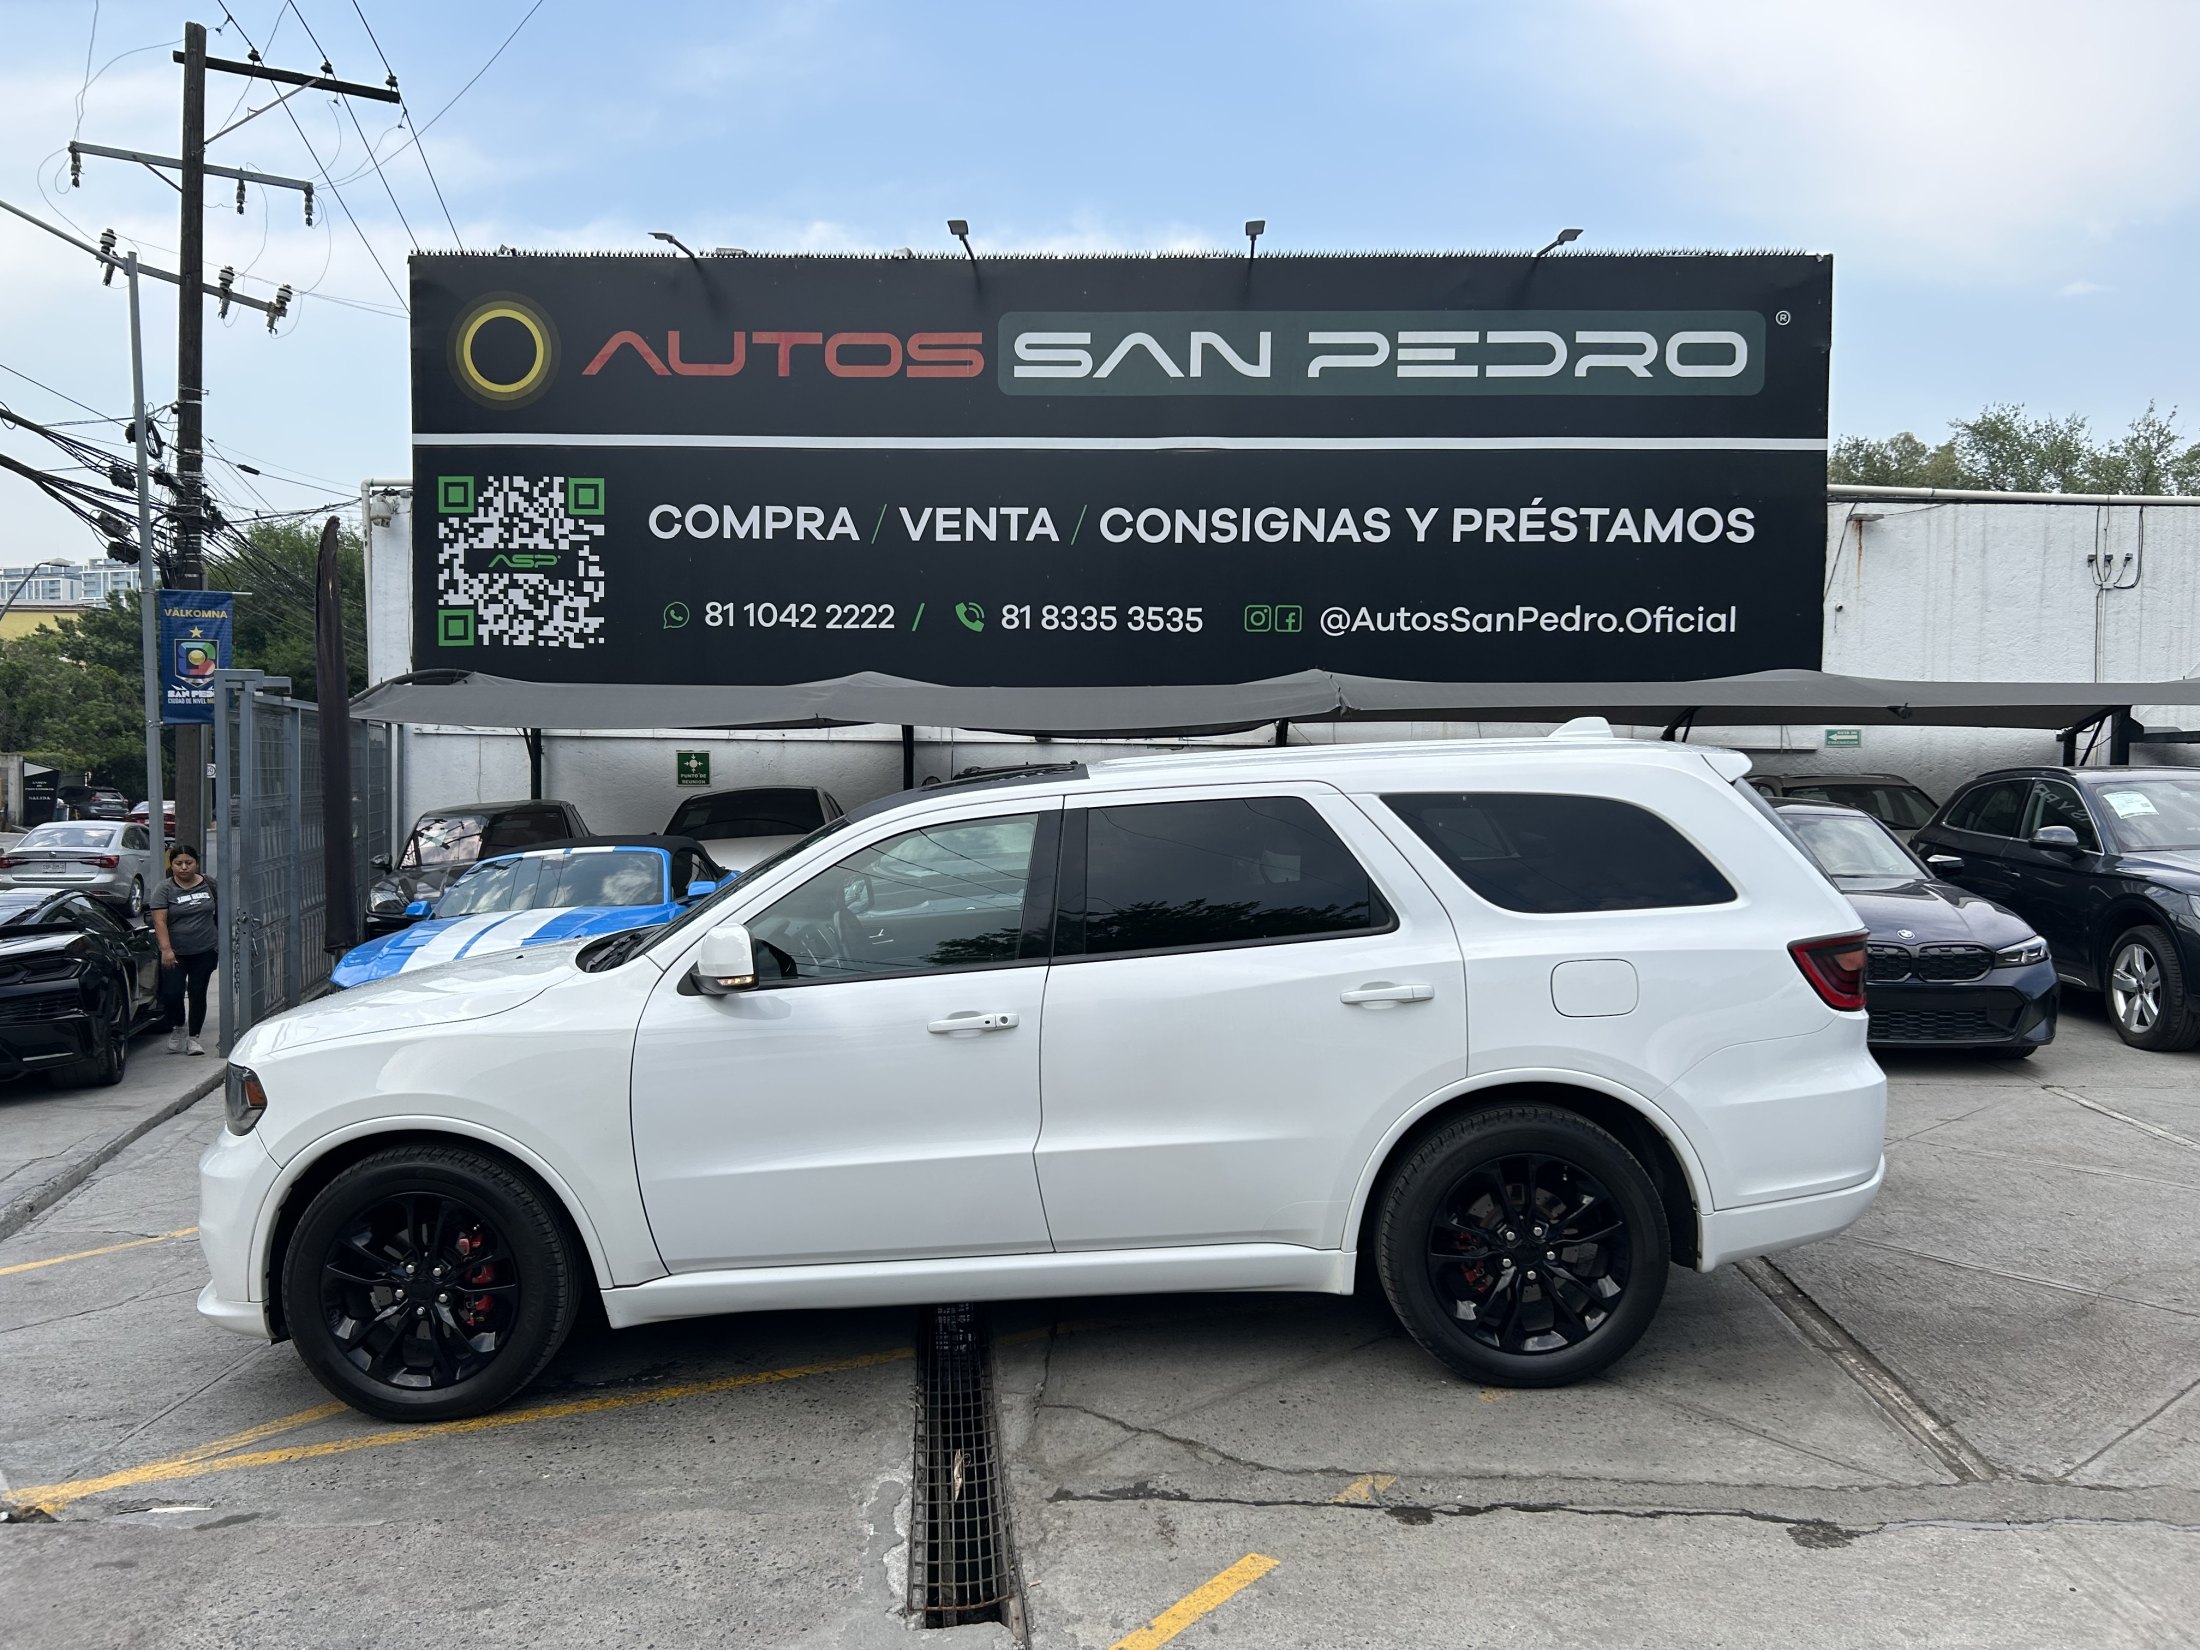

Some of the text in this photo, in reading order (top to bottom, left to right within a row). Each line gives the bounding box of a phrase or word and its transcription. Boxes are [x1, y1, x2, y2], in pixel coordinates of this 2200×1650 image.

[582, 330, 985, 378] AUTOS
[1013, 331, 1272, 378] SAN
[1307, 330, 1748, 378] PEDRO
[648, 503, 860, 542] COMPRA
[898, 506, 1060, 543] VENTA
[1099, 506, 1392, 545] CONSIGNAS
[1405, 507, 1440, 543] Y
[1452, 497, 1755, 544] PRÉSTAMOS
[488, 554, 558, 568] ASP
[164, 607, 228, 619] VÄLKOMNA
[704, 601, 735, 628] 81
[743, 602, 818, 630] 1042
[825, 603, 896, 630] 2222
[1001, 604, 1204, 633] 81 8335 3535
[1319, 603, 1737, 638] @AutosSanPedro.Oficial
[167, 690, 190, 698] SAN
